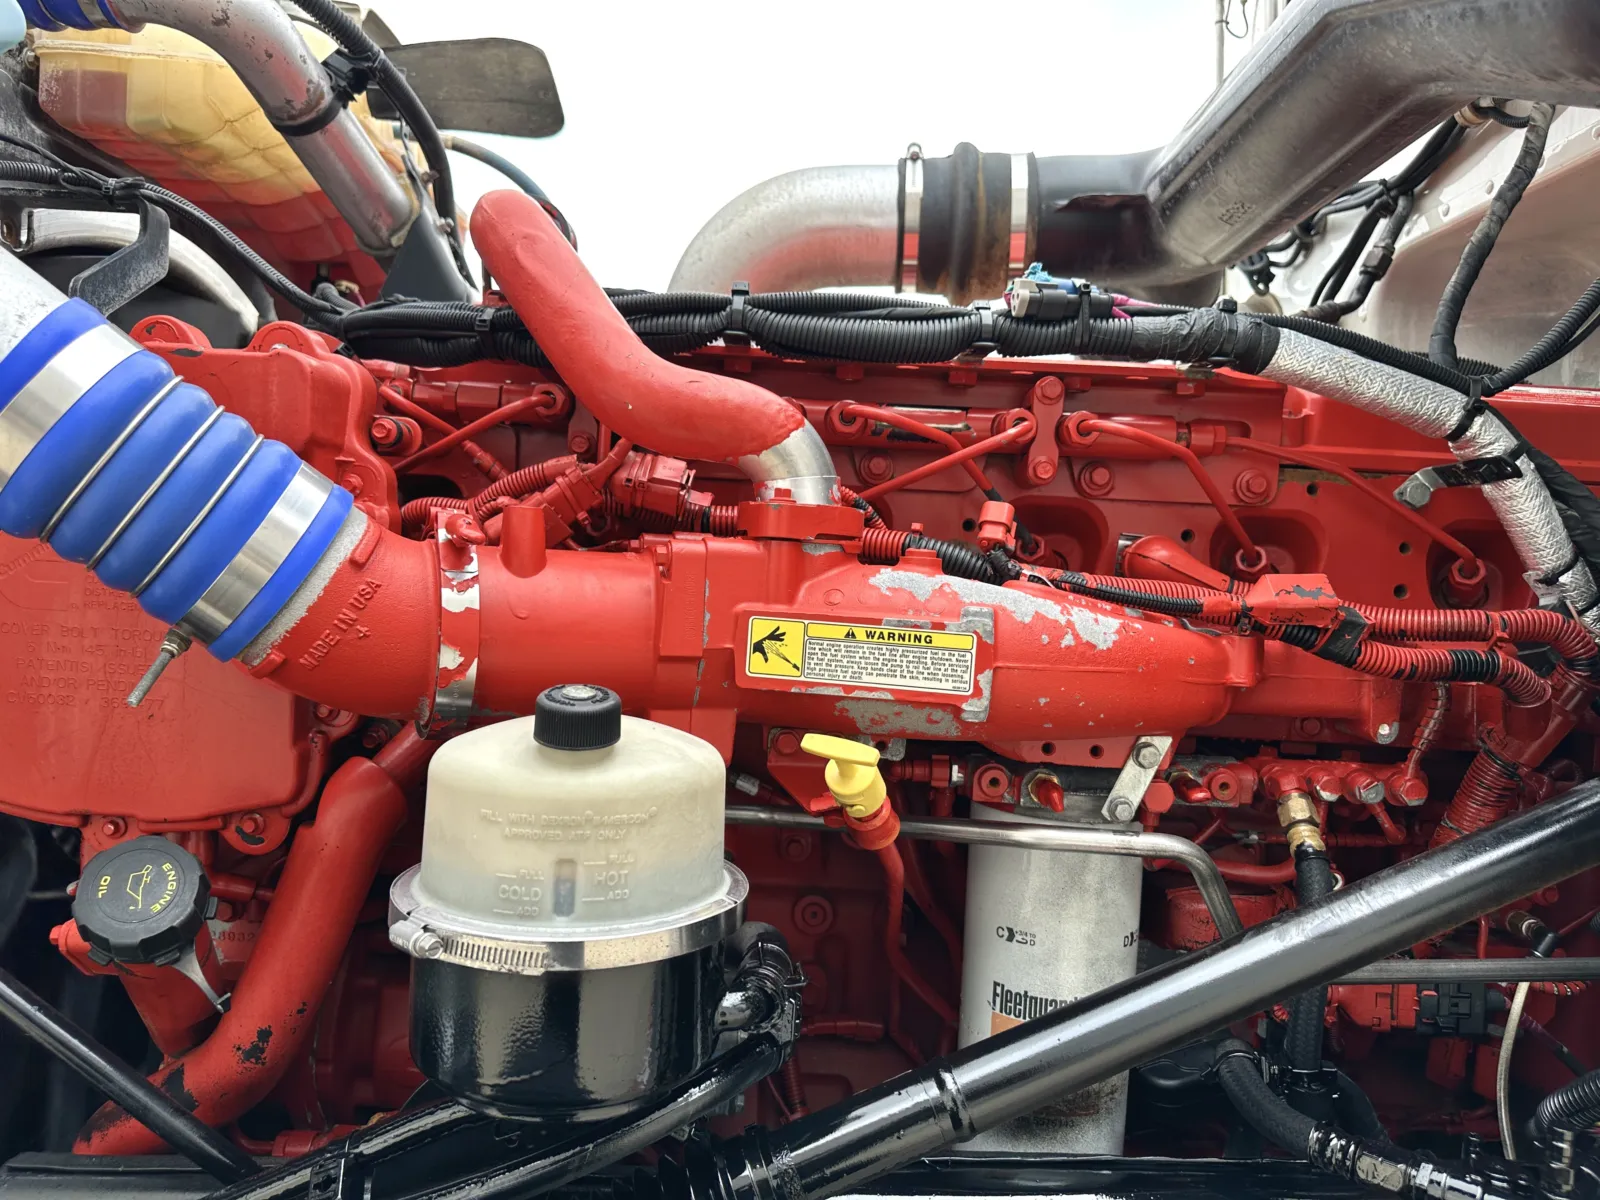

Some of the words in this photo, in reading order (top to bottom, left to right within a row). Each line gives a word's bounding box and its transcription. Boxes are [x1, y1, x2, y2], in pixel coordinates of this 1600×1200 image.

[1, 621, 50, 636] COVER
[60, 624, 99, 638] BOLT
[299, 630, 341, 670] MADE
[333, 608, 358, 632] IN
[348, 578, 382, 609] USA
[865, 630, 933, 644] WARNING
[104, 662, 147, 676] ISSUE
[905, 658, 929, 666] operating.
[480, 808, 503, 822] FILL
[508, 812, 535, 825] WITH
[503, 828, 564, 840] APPROVED
[569, 831, 592, 840] ATF
[597, 828, 627, 840] ONLY
[609, 854, 635, 863] FULL
[519, 868, 544, 881] FULL
[595, 870, 629, 886] HOT
[98, 875, 111, 899] OIL
[150, 862, 177, 914] ENGINE
[499, 884, 542, 901] COLD
[607, 888, 629, 900] ADD
[516, 906, 539, 916] ADD
[996, 926, 1005, 939] C
